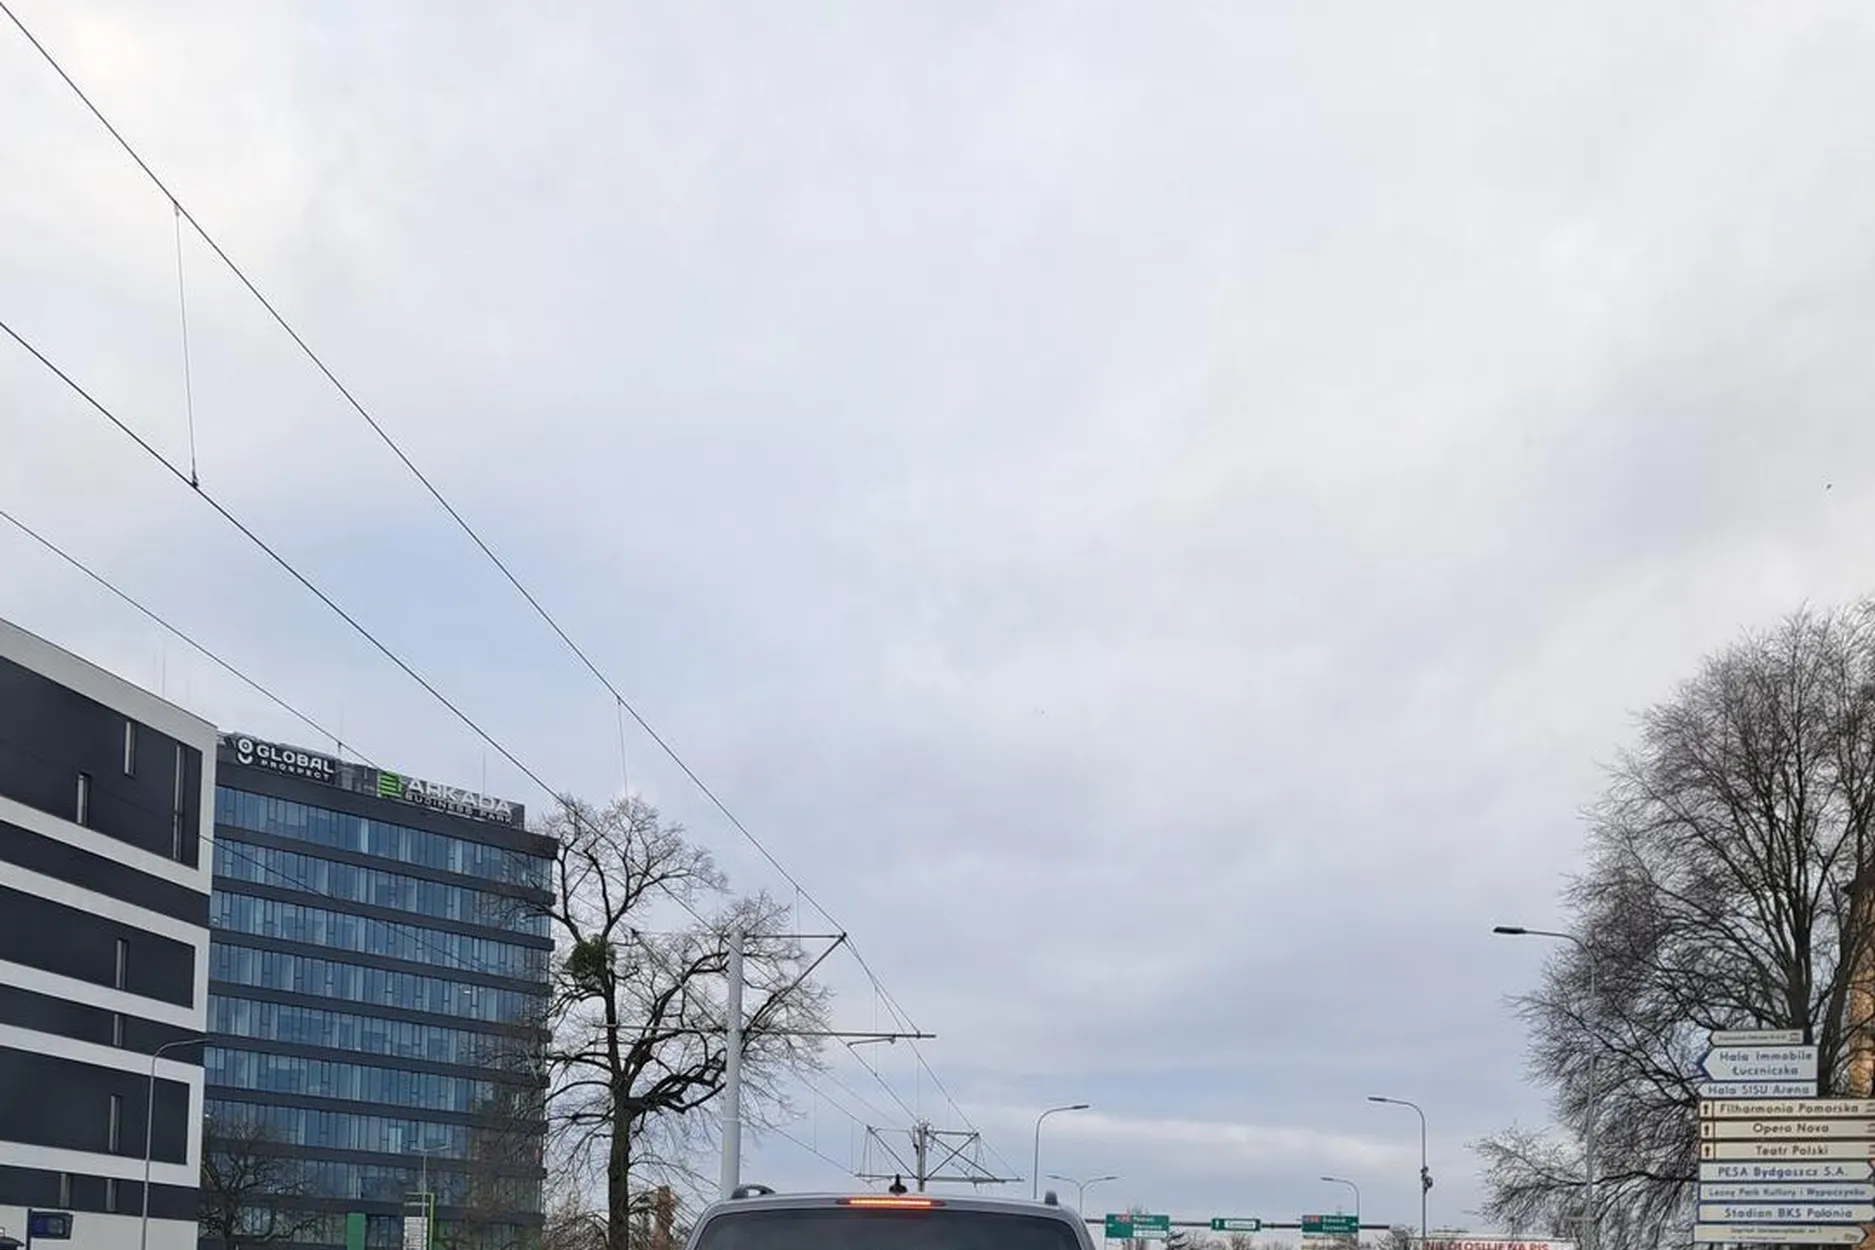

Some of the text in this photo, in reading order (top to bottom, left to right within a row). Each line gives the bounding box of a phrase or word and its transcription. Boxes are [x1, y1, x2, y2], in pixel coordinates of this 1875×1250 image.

[256, 744, 334, 774] GLOBAL
[260, 759, 330, 781] PROSPECT
[406, 777, 513, 816] ARKADA
[404, 791, 513, 825] BUSINESS PARK
[1719, 1050, 1812, 1062] Hala Immobile
[1732, 1065, 1799, 1077] Łuczniczka
[1708, 1083, 1811, 1095] Hala SISU Arena
[1719, 1103, 1860, 1114] Filharmonia Pomorska
[1752, 1122, 1830, 1135] Opera Nova
[1755, 1145, 1829, 1156] Teatr Polski
[1718, 1166, 1848, 1179] PESA Bydgoszcz S.A.
[1724, 1207, 1853, 1218] Stadion BKS Polonia
